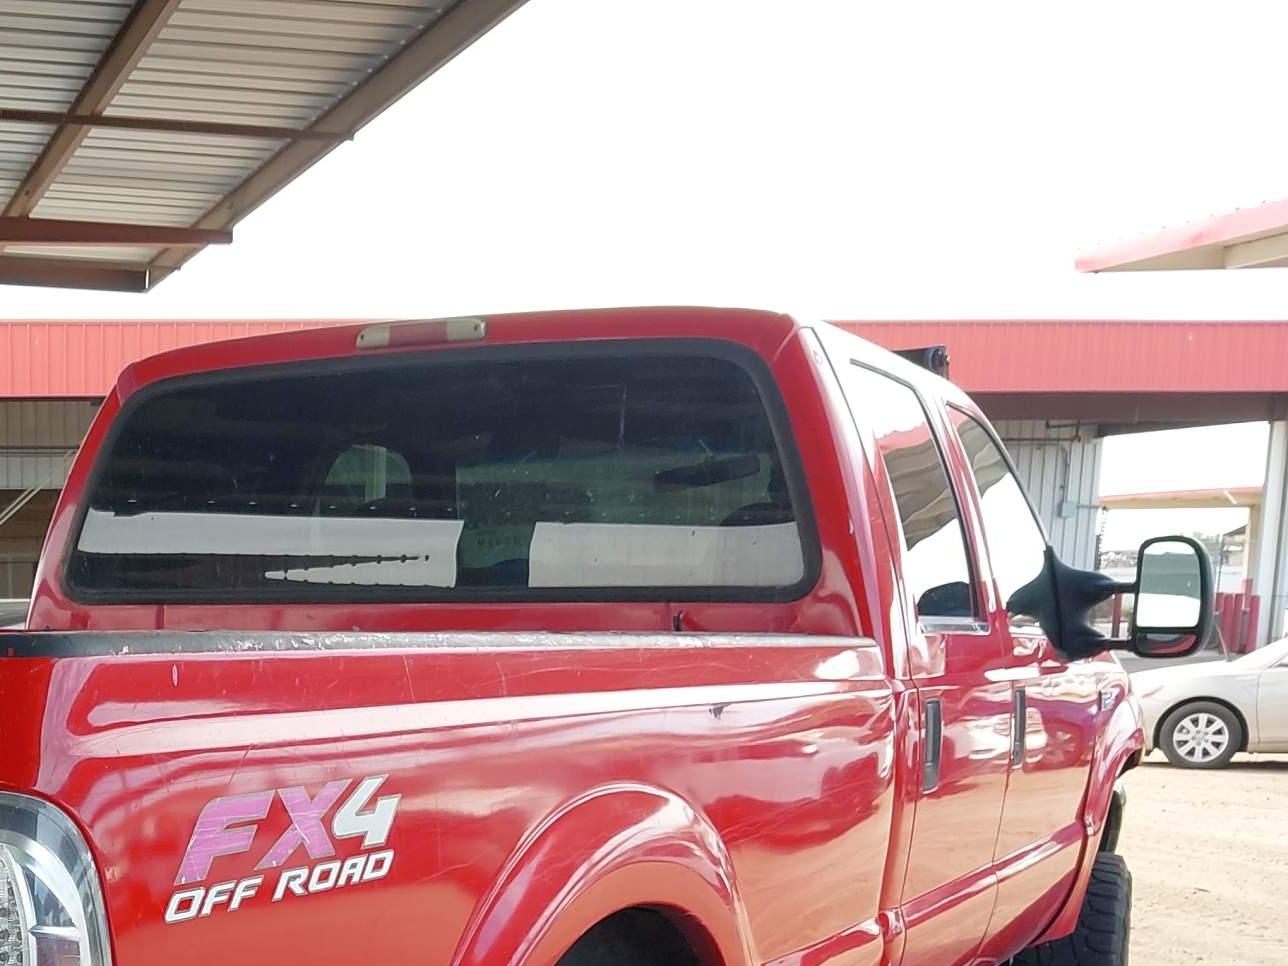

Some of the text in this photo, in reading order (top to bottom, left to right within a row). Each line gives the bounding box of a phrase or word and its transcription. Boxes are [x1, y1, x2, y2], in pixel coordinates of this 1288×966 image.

[174, 773, 402, 886] FX4
[164, 850, 395, 924] OFF ROAD
